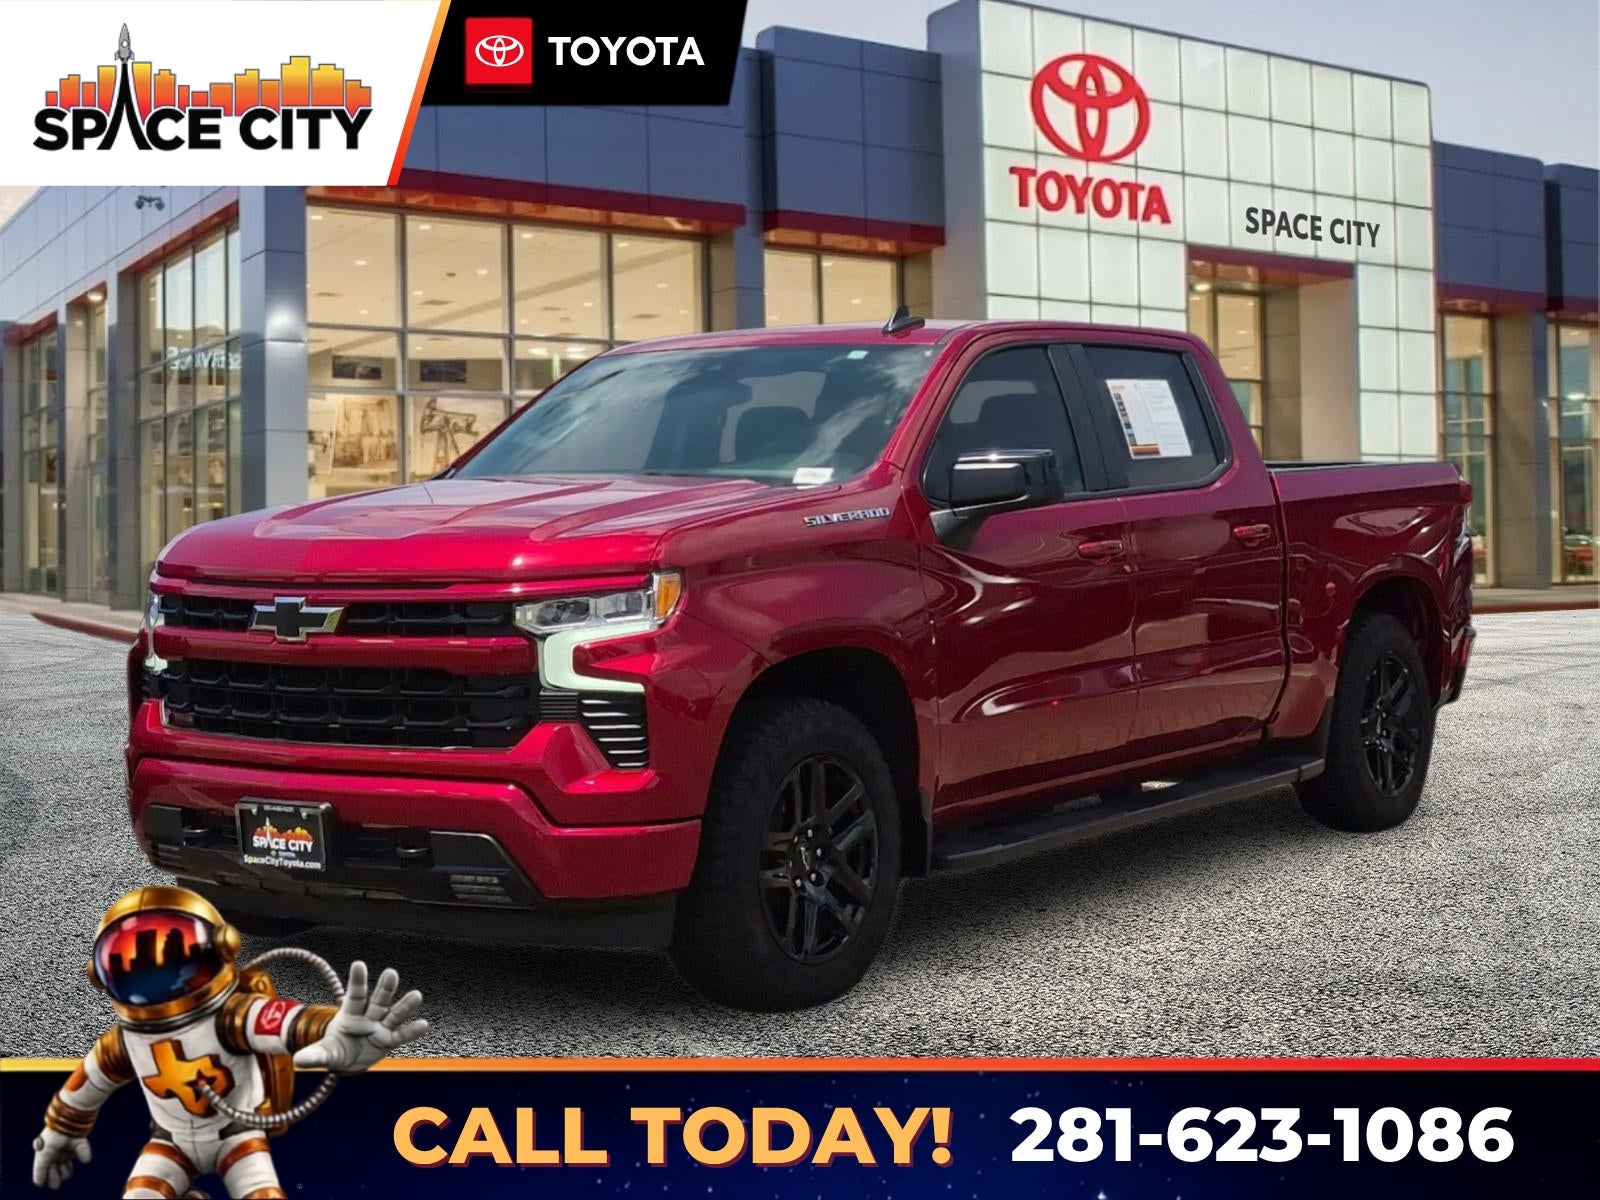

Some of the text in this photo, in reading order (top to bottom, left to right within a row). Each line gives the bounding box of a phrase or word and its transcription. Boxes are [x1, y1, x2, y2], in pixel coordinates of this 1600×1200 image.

[1009, 166, 1171, 224] TOYOTA
[1245, 206, 1380, 248] SPACE CITY
[803, 507, 890, 527] SILVERADO
[253, 836, 314, 852] SPACE CITY
[243, 854, 321, 869] SpaceCityToyota.com
